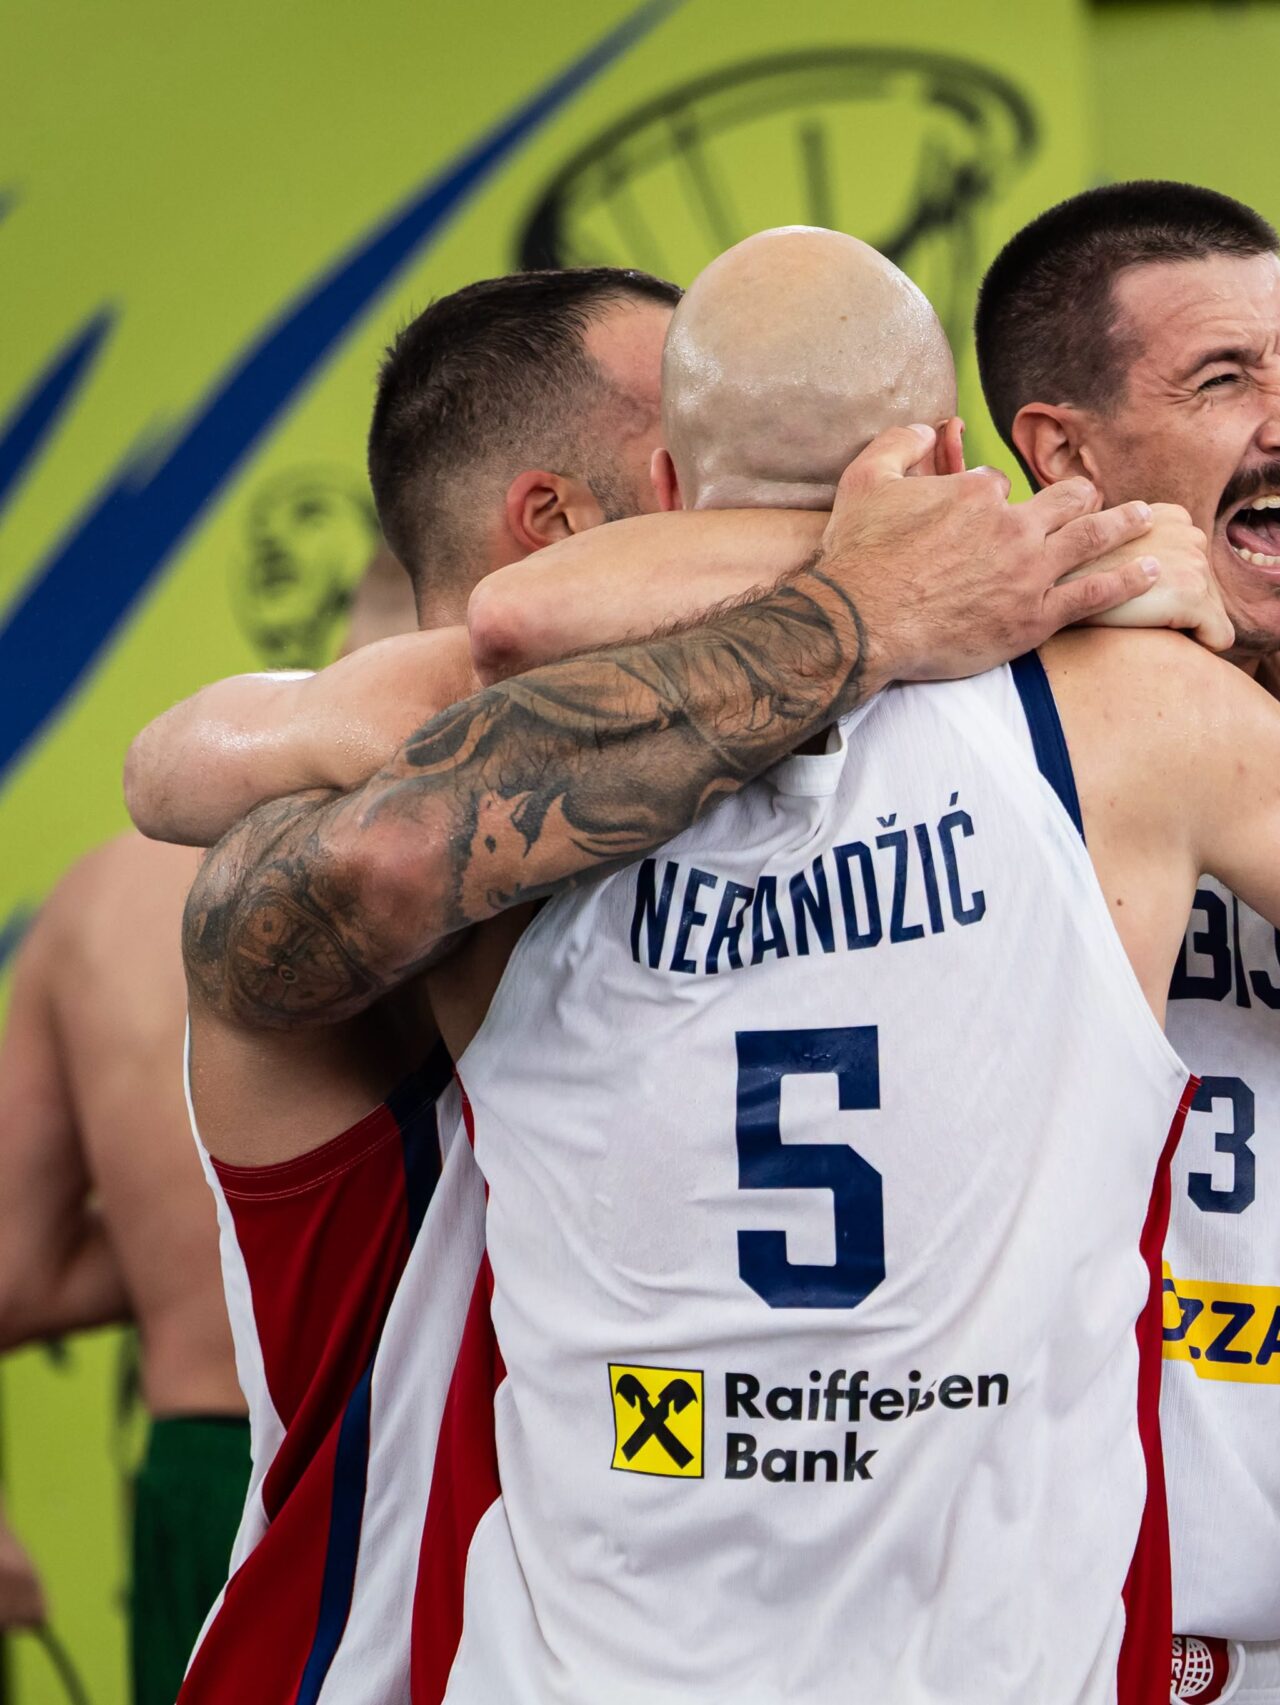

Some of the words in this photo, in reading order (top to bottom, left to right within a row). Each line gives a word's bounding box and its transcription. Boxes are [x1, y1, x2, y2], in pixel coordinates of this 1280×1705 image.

[630, 791, 986, 975] NERANDŽIĆ
[735, 1024, 886, 1309] 5
[1188, 1075, 1256, 1214] 3
[724, 1431, 879, 1483] Bank
